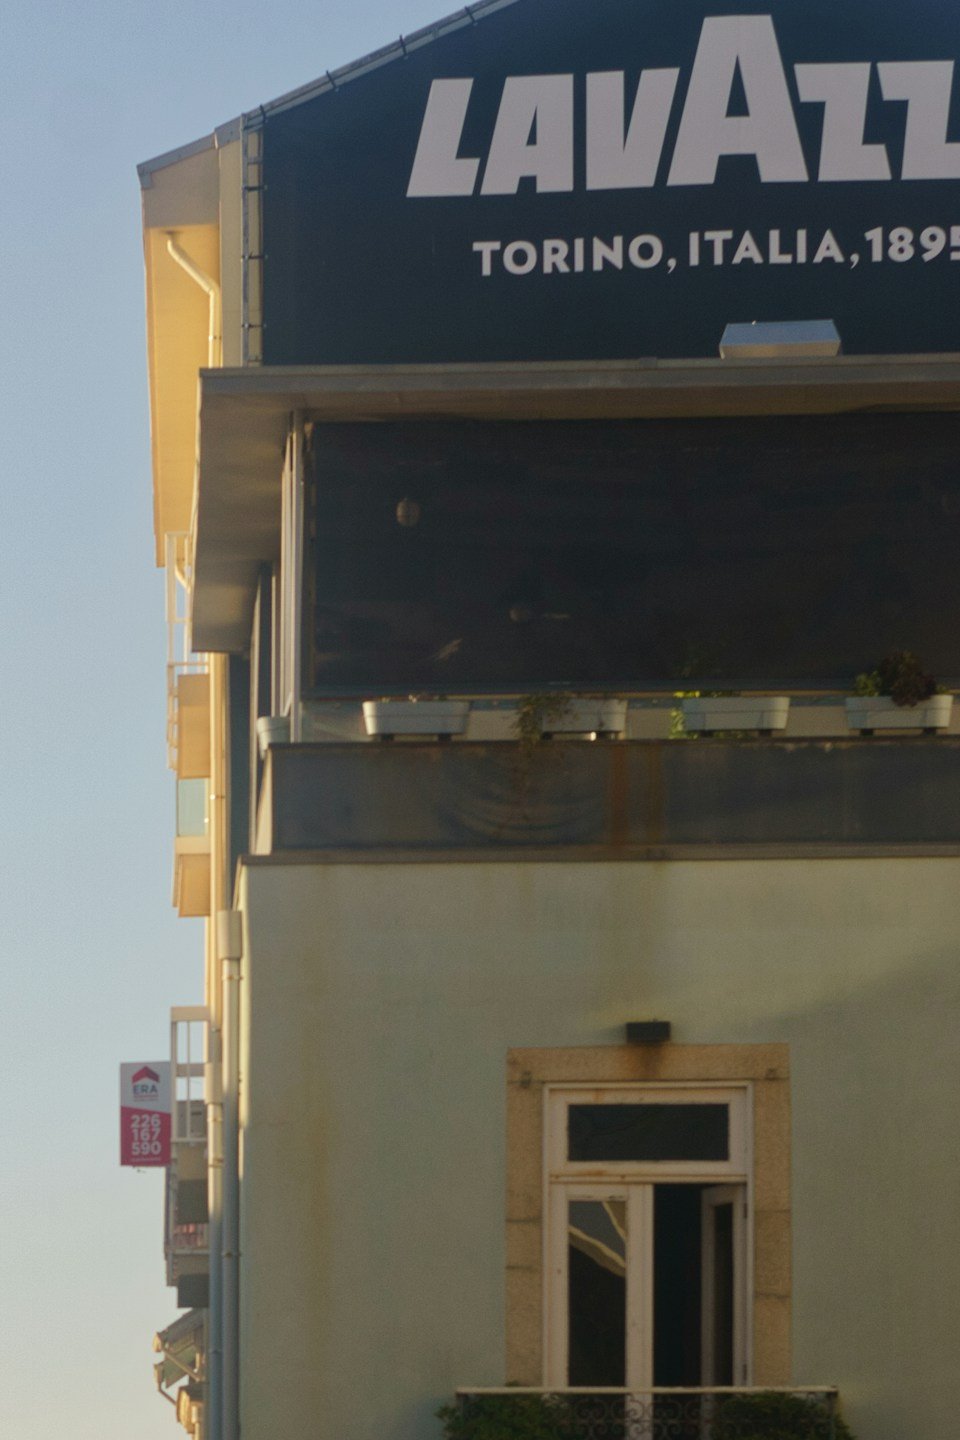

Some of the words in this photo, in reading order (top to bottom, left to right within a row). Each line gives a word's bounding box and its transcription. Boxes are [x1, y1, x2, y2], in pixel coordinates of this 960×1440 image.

[472, 234, 676, 276] TORINO,
[688, 229, 859, 269] ITALIA,
[133, 1084, 158, 1095] ERA
[131, 1114, 161, 1128] 226
[132, 1128, 161, 1142] 167
[132, 1141, 162, 1155] 590
